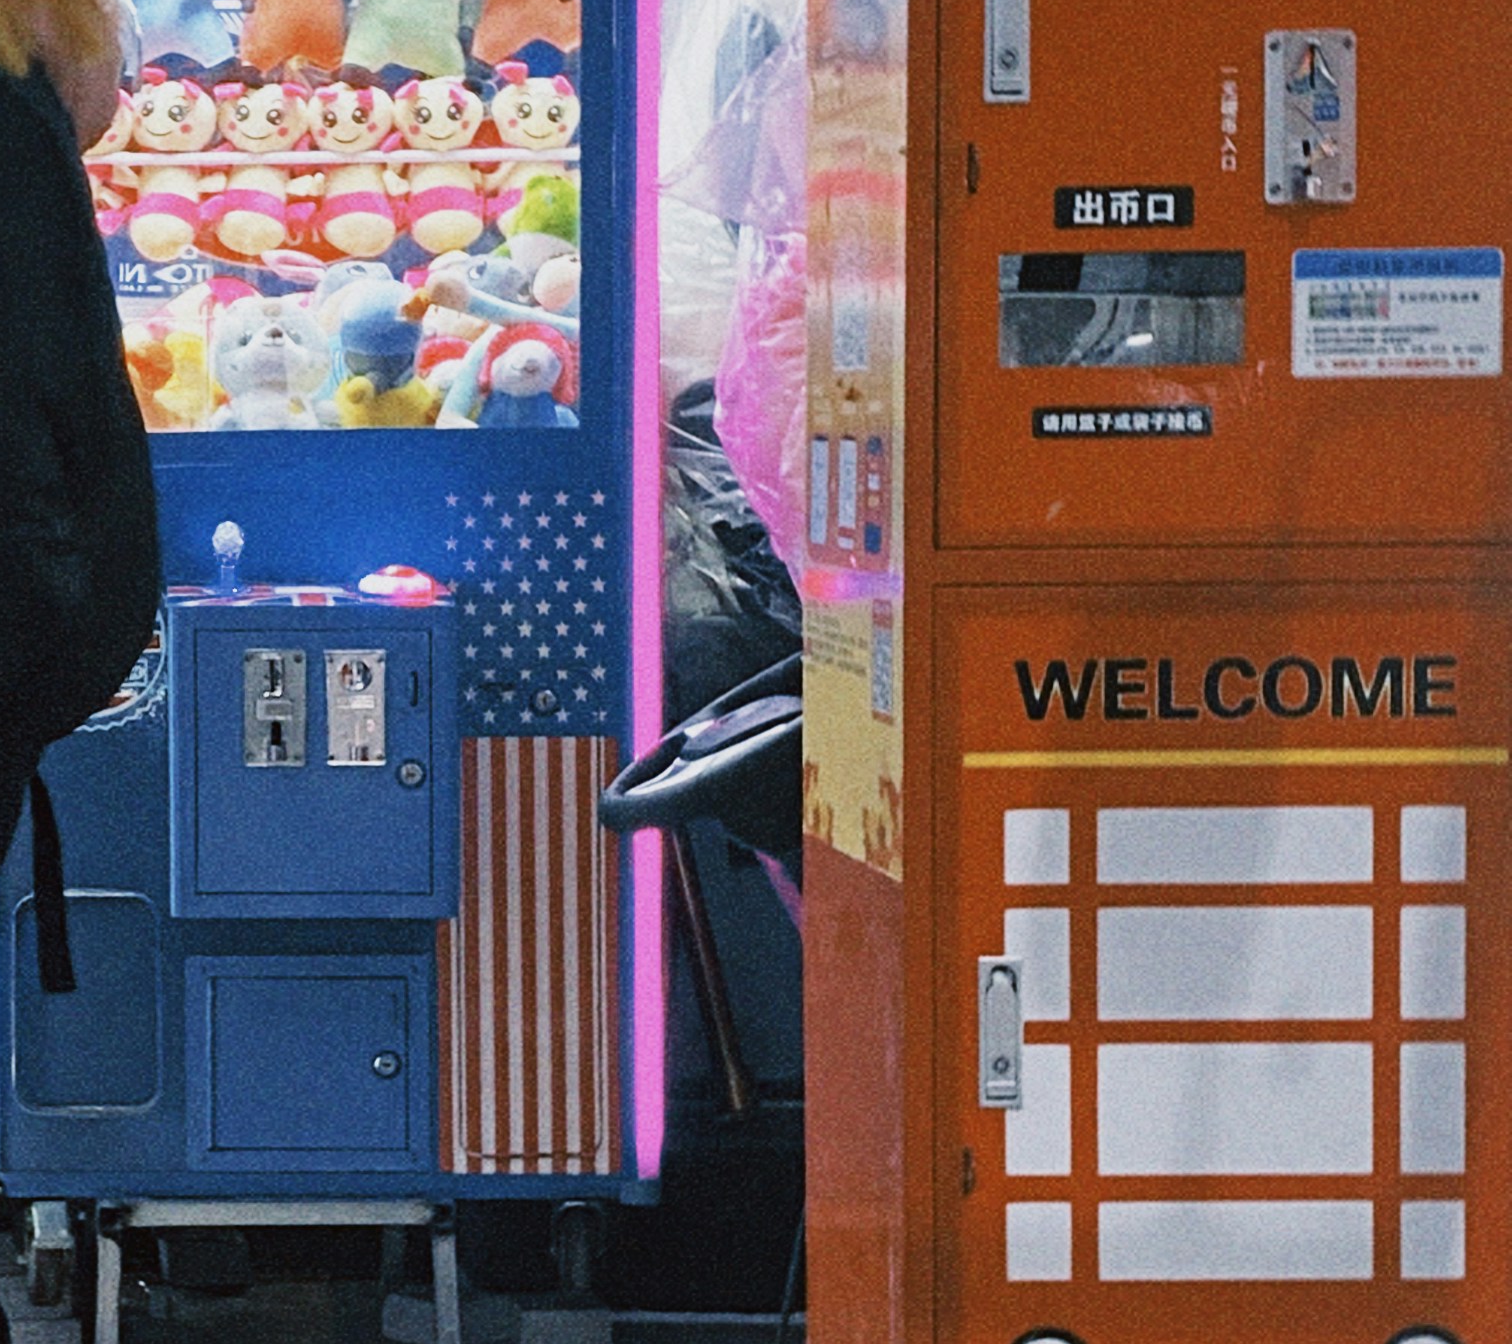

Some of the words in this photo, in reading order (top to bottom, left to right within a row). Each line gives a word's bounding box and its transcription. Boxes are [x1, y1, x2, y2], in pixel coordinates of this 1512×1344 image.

[1073, 190, 1176, 226] 出币口
[1014, 655, 1458, 722] WELCOME
